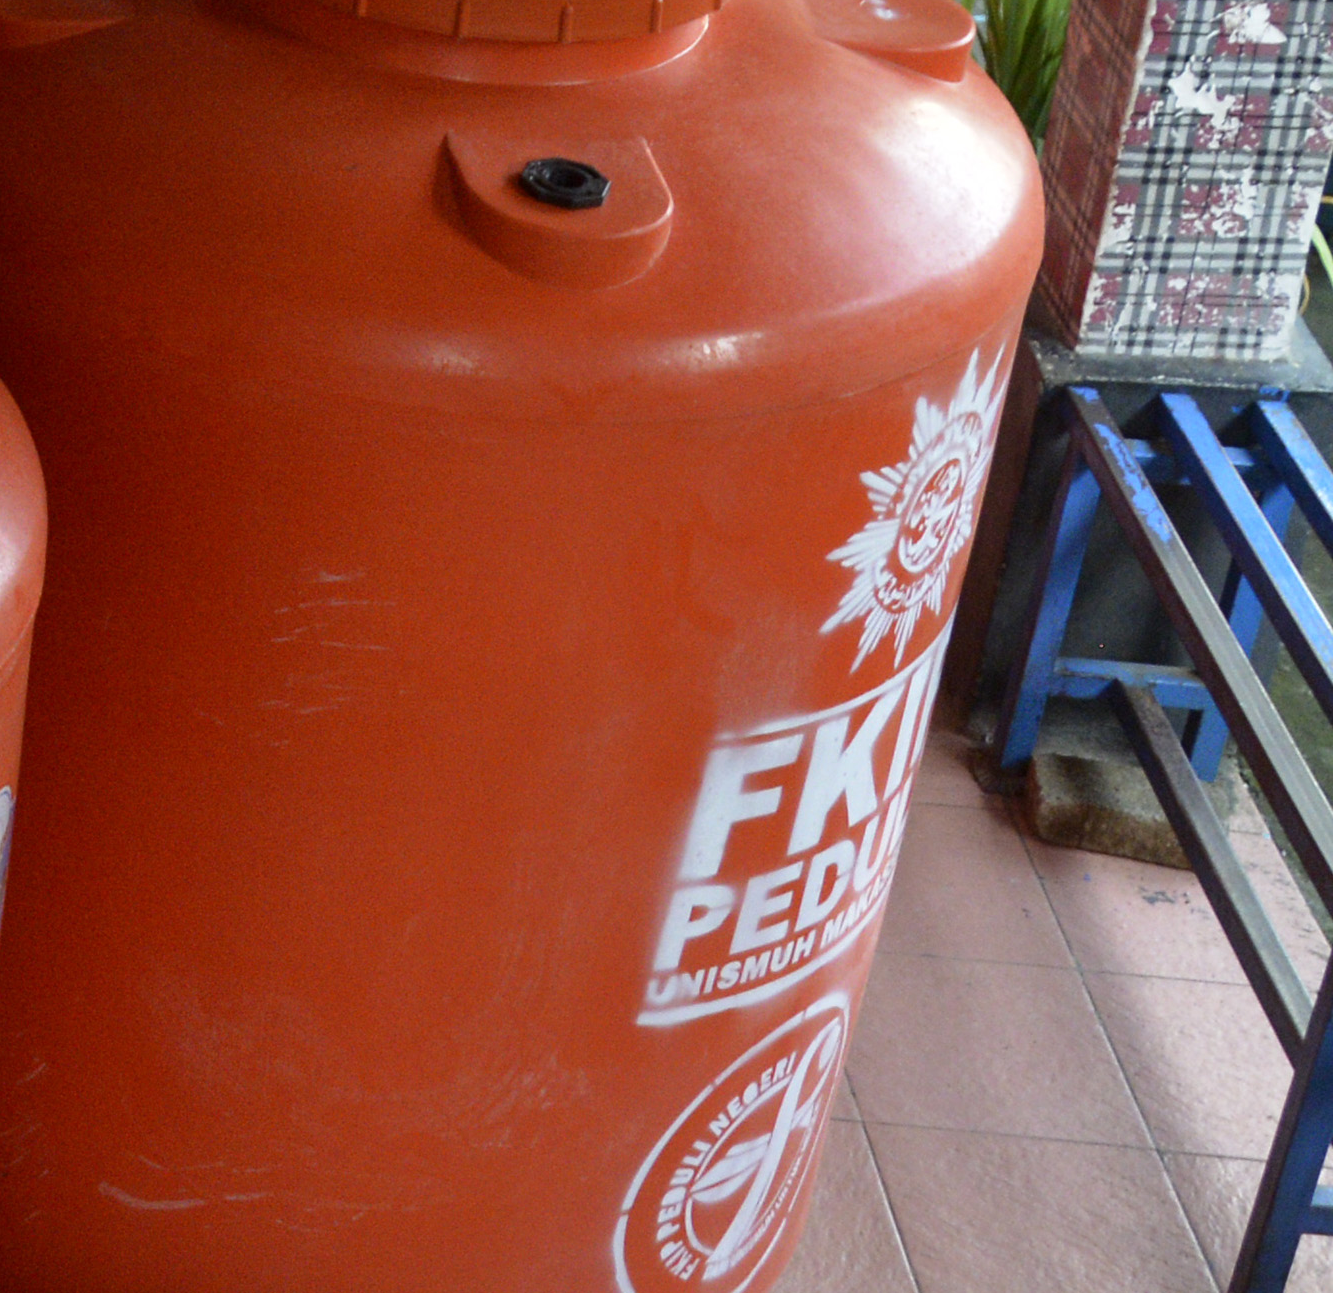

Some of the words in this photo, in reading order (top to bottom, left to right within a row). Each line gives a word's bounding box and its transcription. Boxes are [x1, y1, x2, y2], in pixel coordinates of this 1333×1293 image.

[646, 930, 817, 1007] UNISMUH
[656, 1140, 712, 1242] PEDULI
[708, 1050, 798, 1137] NEGERI
